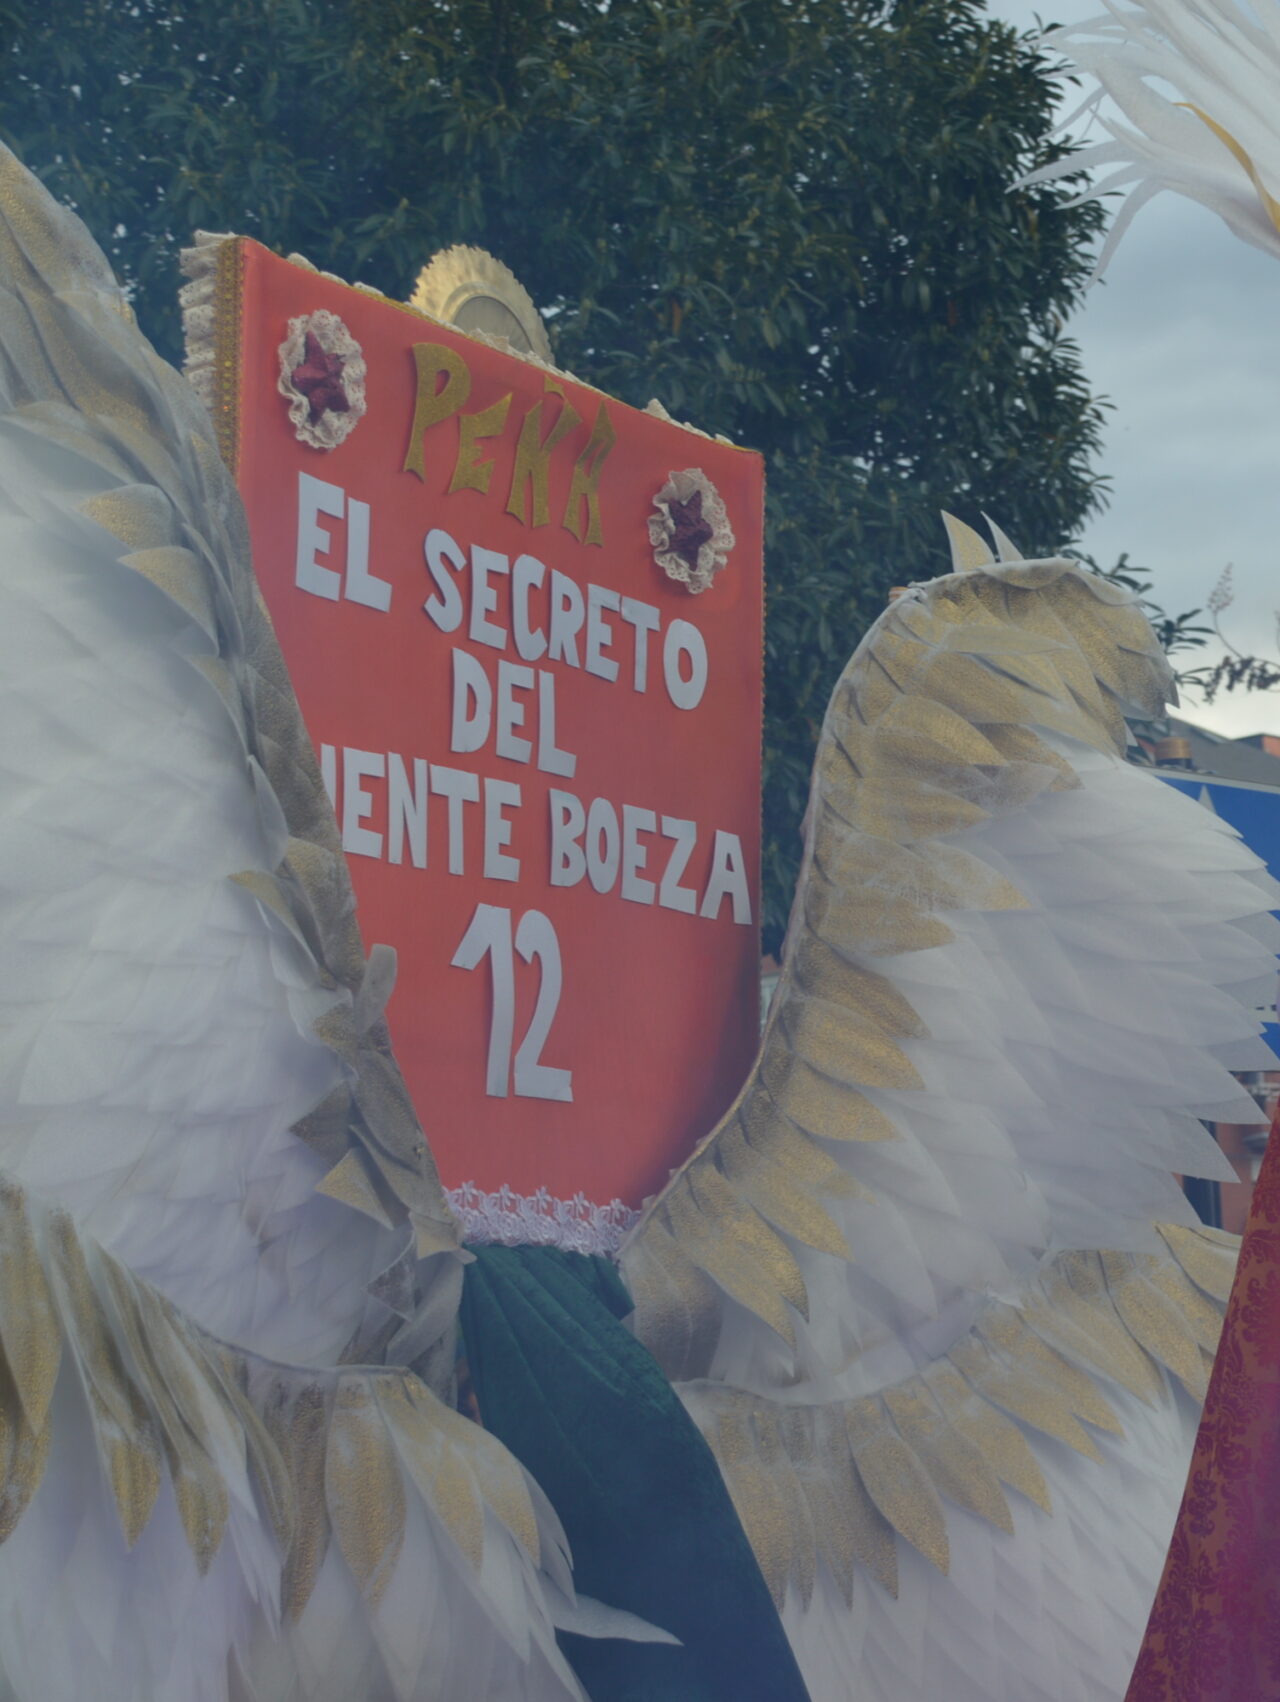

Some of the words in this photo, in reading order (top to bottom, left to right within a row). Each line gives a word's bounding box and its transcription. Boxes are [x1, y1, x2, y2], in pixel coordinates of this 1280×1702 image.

[295, 470, 392, 613] EL
[423, 528, 709, 711] SECRETO
[450, 647, 578, 779] DEL
[320, 742, 522, 883] ENTE
[549, 787, 753, 926] BOEZA
[450, 902, 574, 1103] 12
